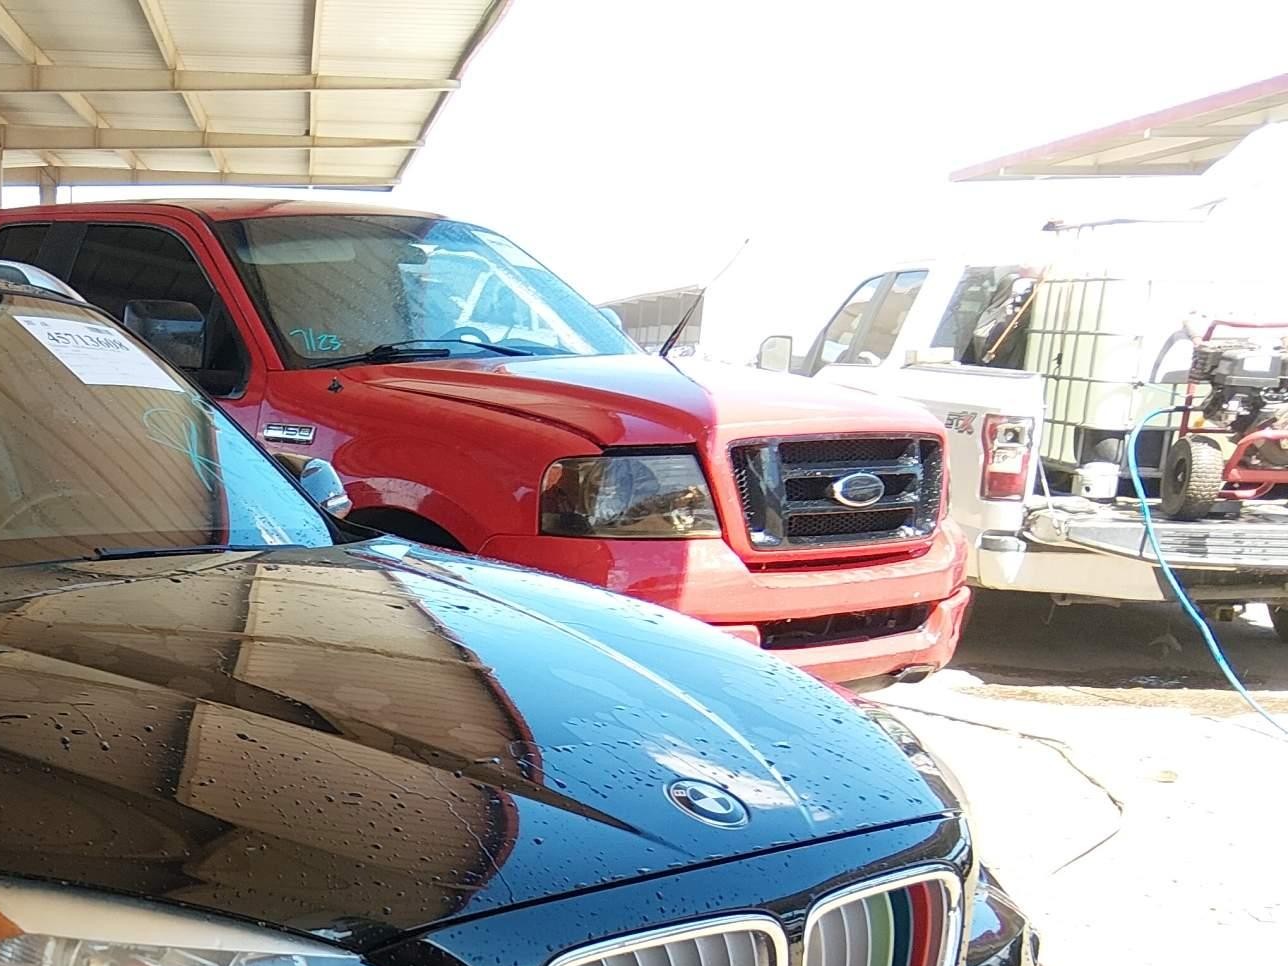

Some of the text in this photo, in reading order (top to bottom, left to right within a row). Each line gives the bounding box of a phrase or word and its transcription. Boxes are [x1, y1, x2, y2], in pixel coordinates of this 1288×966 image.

[46, 331, 130, 351] 45713608
[289, 327, 341, 352] 7/23
[944, 411, 978, 435] STX
